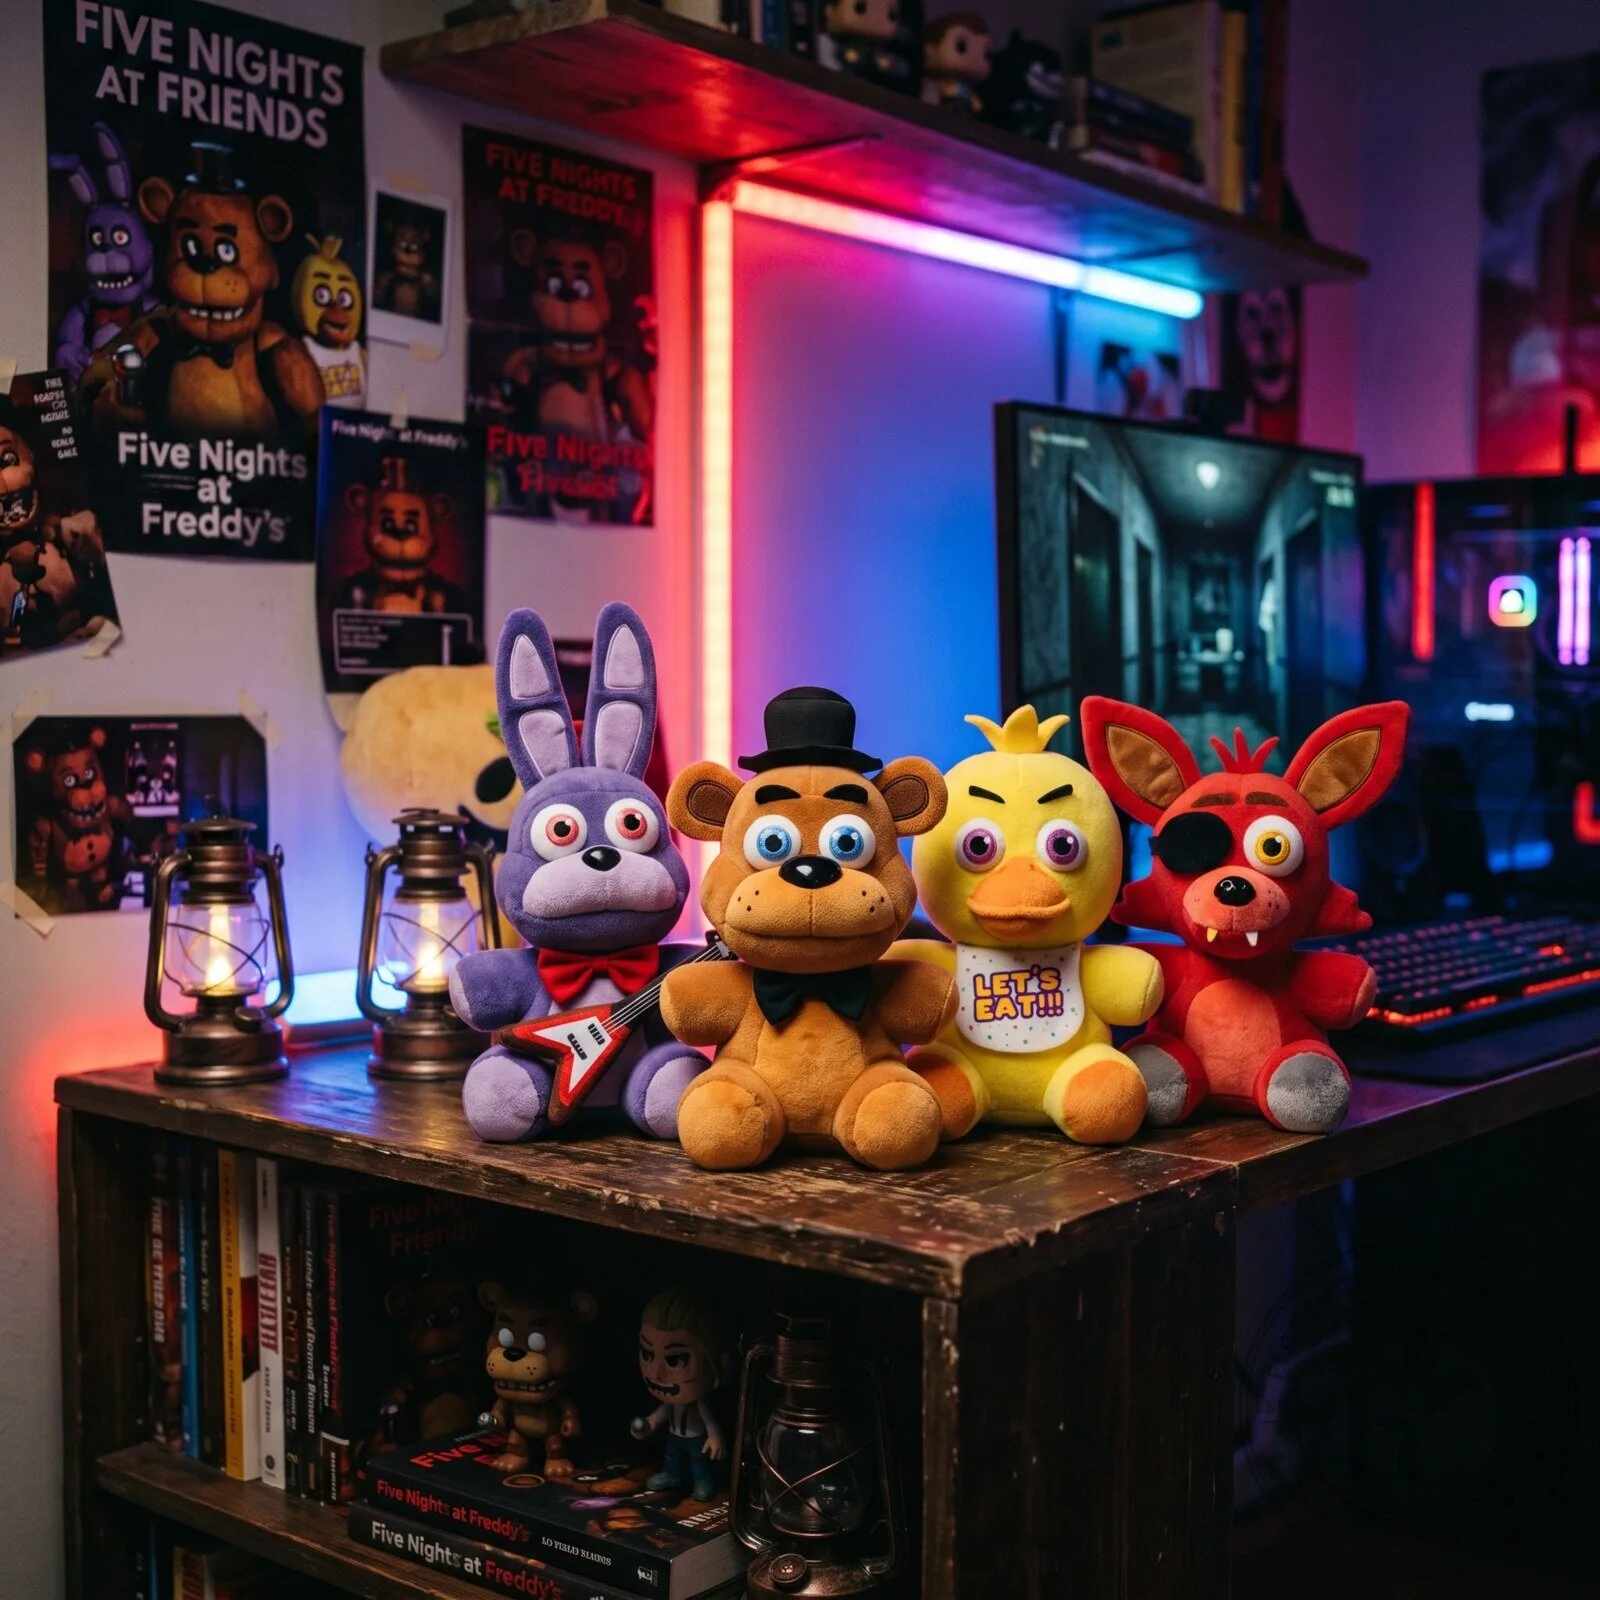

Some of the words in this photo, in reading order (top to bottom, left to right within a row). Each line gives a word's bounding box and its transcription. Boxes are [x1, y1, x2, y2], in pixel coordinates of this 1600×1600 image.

[76, 0, 174, 64] FIVE
[188, 27, 345, 107] NIGHTS
[95, 65, 145, 107] AT
[157, 71, 328, 149] FRIENDS
[486, 142, 544, 178] FIVE
[550, 157, 636, 201] NIGHTS
[499, 176, 530, 204] AT
[332, 420, 357, 437] Five
[118, 431, 191, 470] Five
[199, 439, 308, 482] Nights
[197, 475, 233, 505] at
[142, 502, 287, 548] Freddy's
[973, 964, 1062, 998] LET'S
[974, 991, 1064, 1023] EAT!!!
[410, 1444, 483, 1468] Five
[377, 1479, 402, 1501] Five
[406, 1488, 450, 1514] Nights
[452, 1506, 467, 1522] at
[469, 1509, 532, 1542] Freddy's
[372, 1520, 404, 1549] Five
[407, 1533, 463, 1567] Nights
[464, 1556, 482, 1576] at
[484, 1560, 567, 1600] Freddy's
